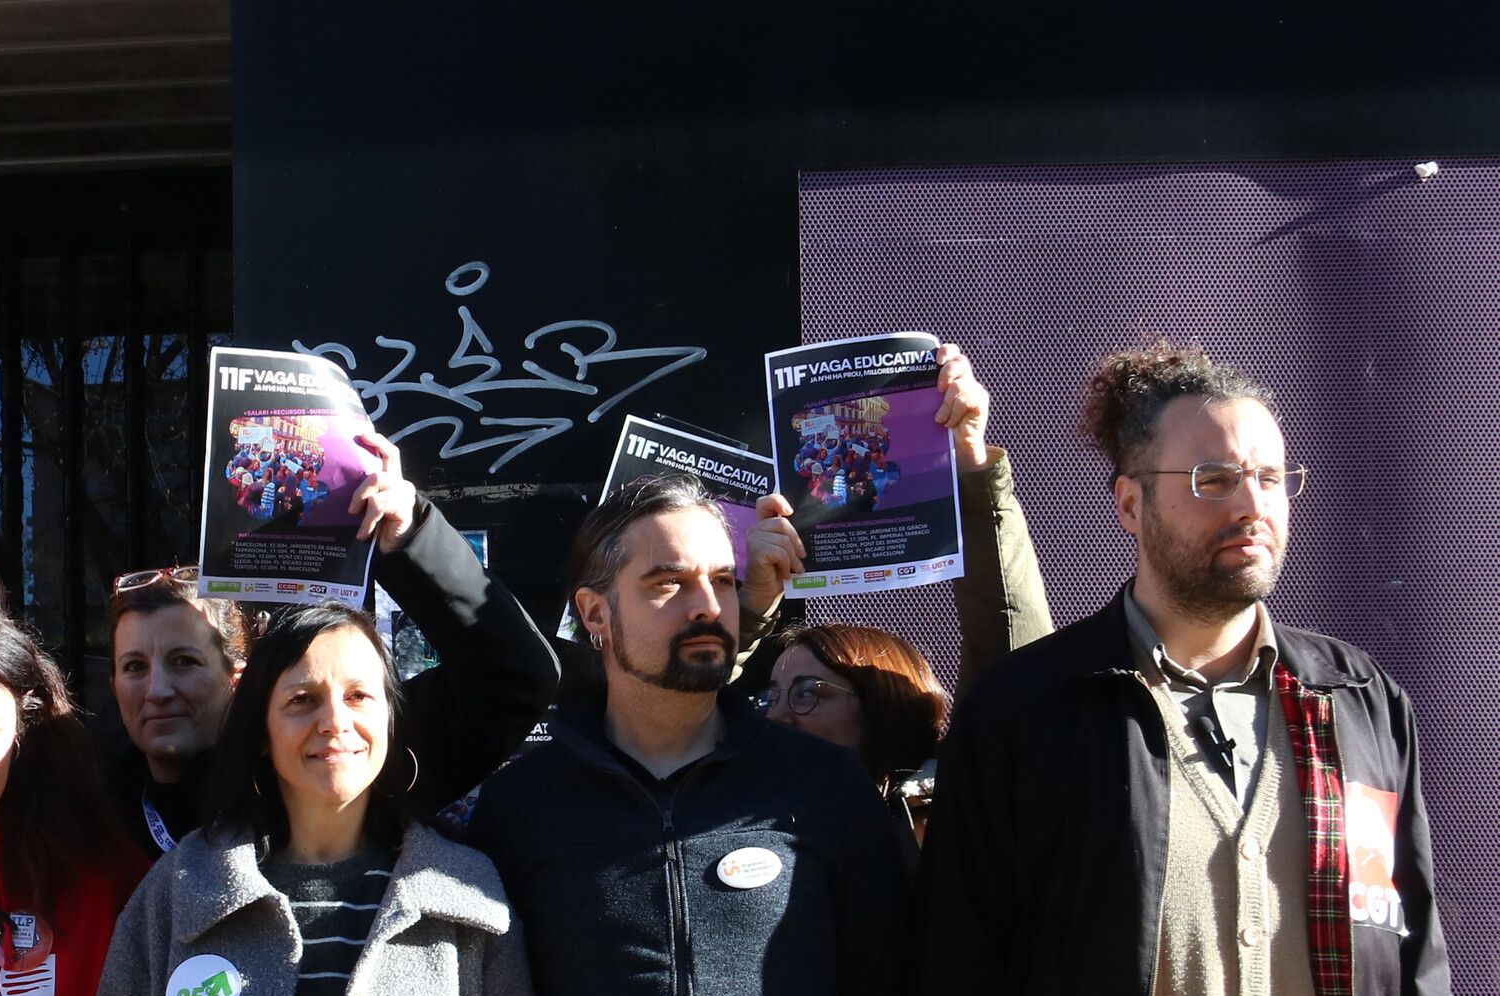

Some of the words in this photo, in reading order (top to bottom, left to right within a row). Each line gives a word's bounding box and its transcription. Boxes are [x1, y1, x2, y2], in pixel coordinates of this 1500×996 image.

[774, 364, 807, 389] 11F
[809, 358, 852, 376] VAGA
[854, 350, 935, 369] EDUCATIVA
[219, 366, 254, 391] 11F
[254, 370, 297, 386] VAGA
[626, 433, 659, 460] 11F
[659, 444, 696, 467] VAGA
[697, 458, 769, 488] EDUCATIVA
[898, 566, 915, 575] CGT
[932, 561, 947, 570] UGT
[309, 584, 326, 594] CGT
[340, 589, 354, 597] UGT
[1348, 881, 1402, 928] CGT
